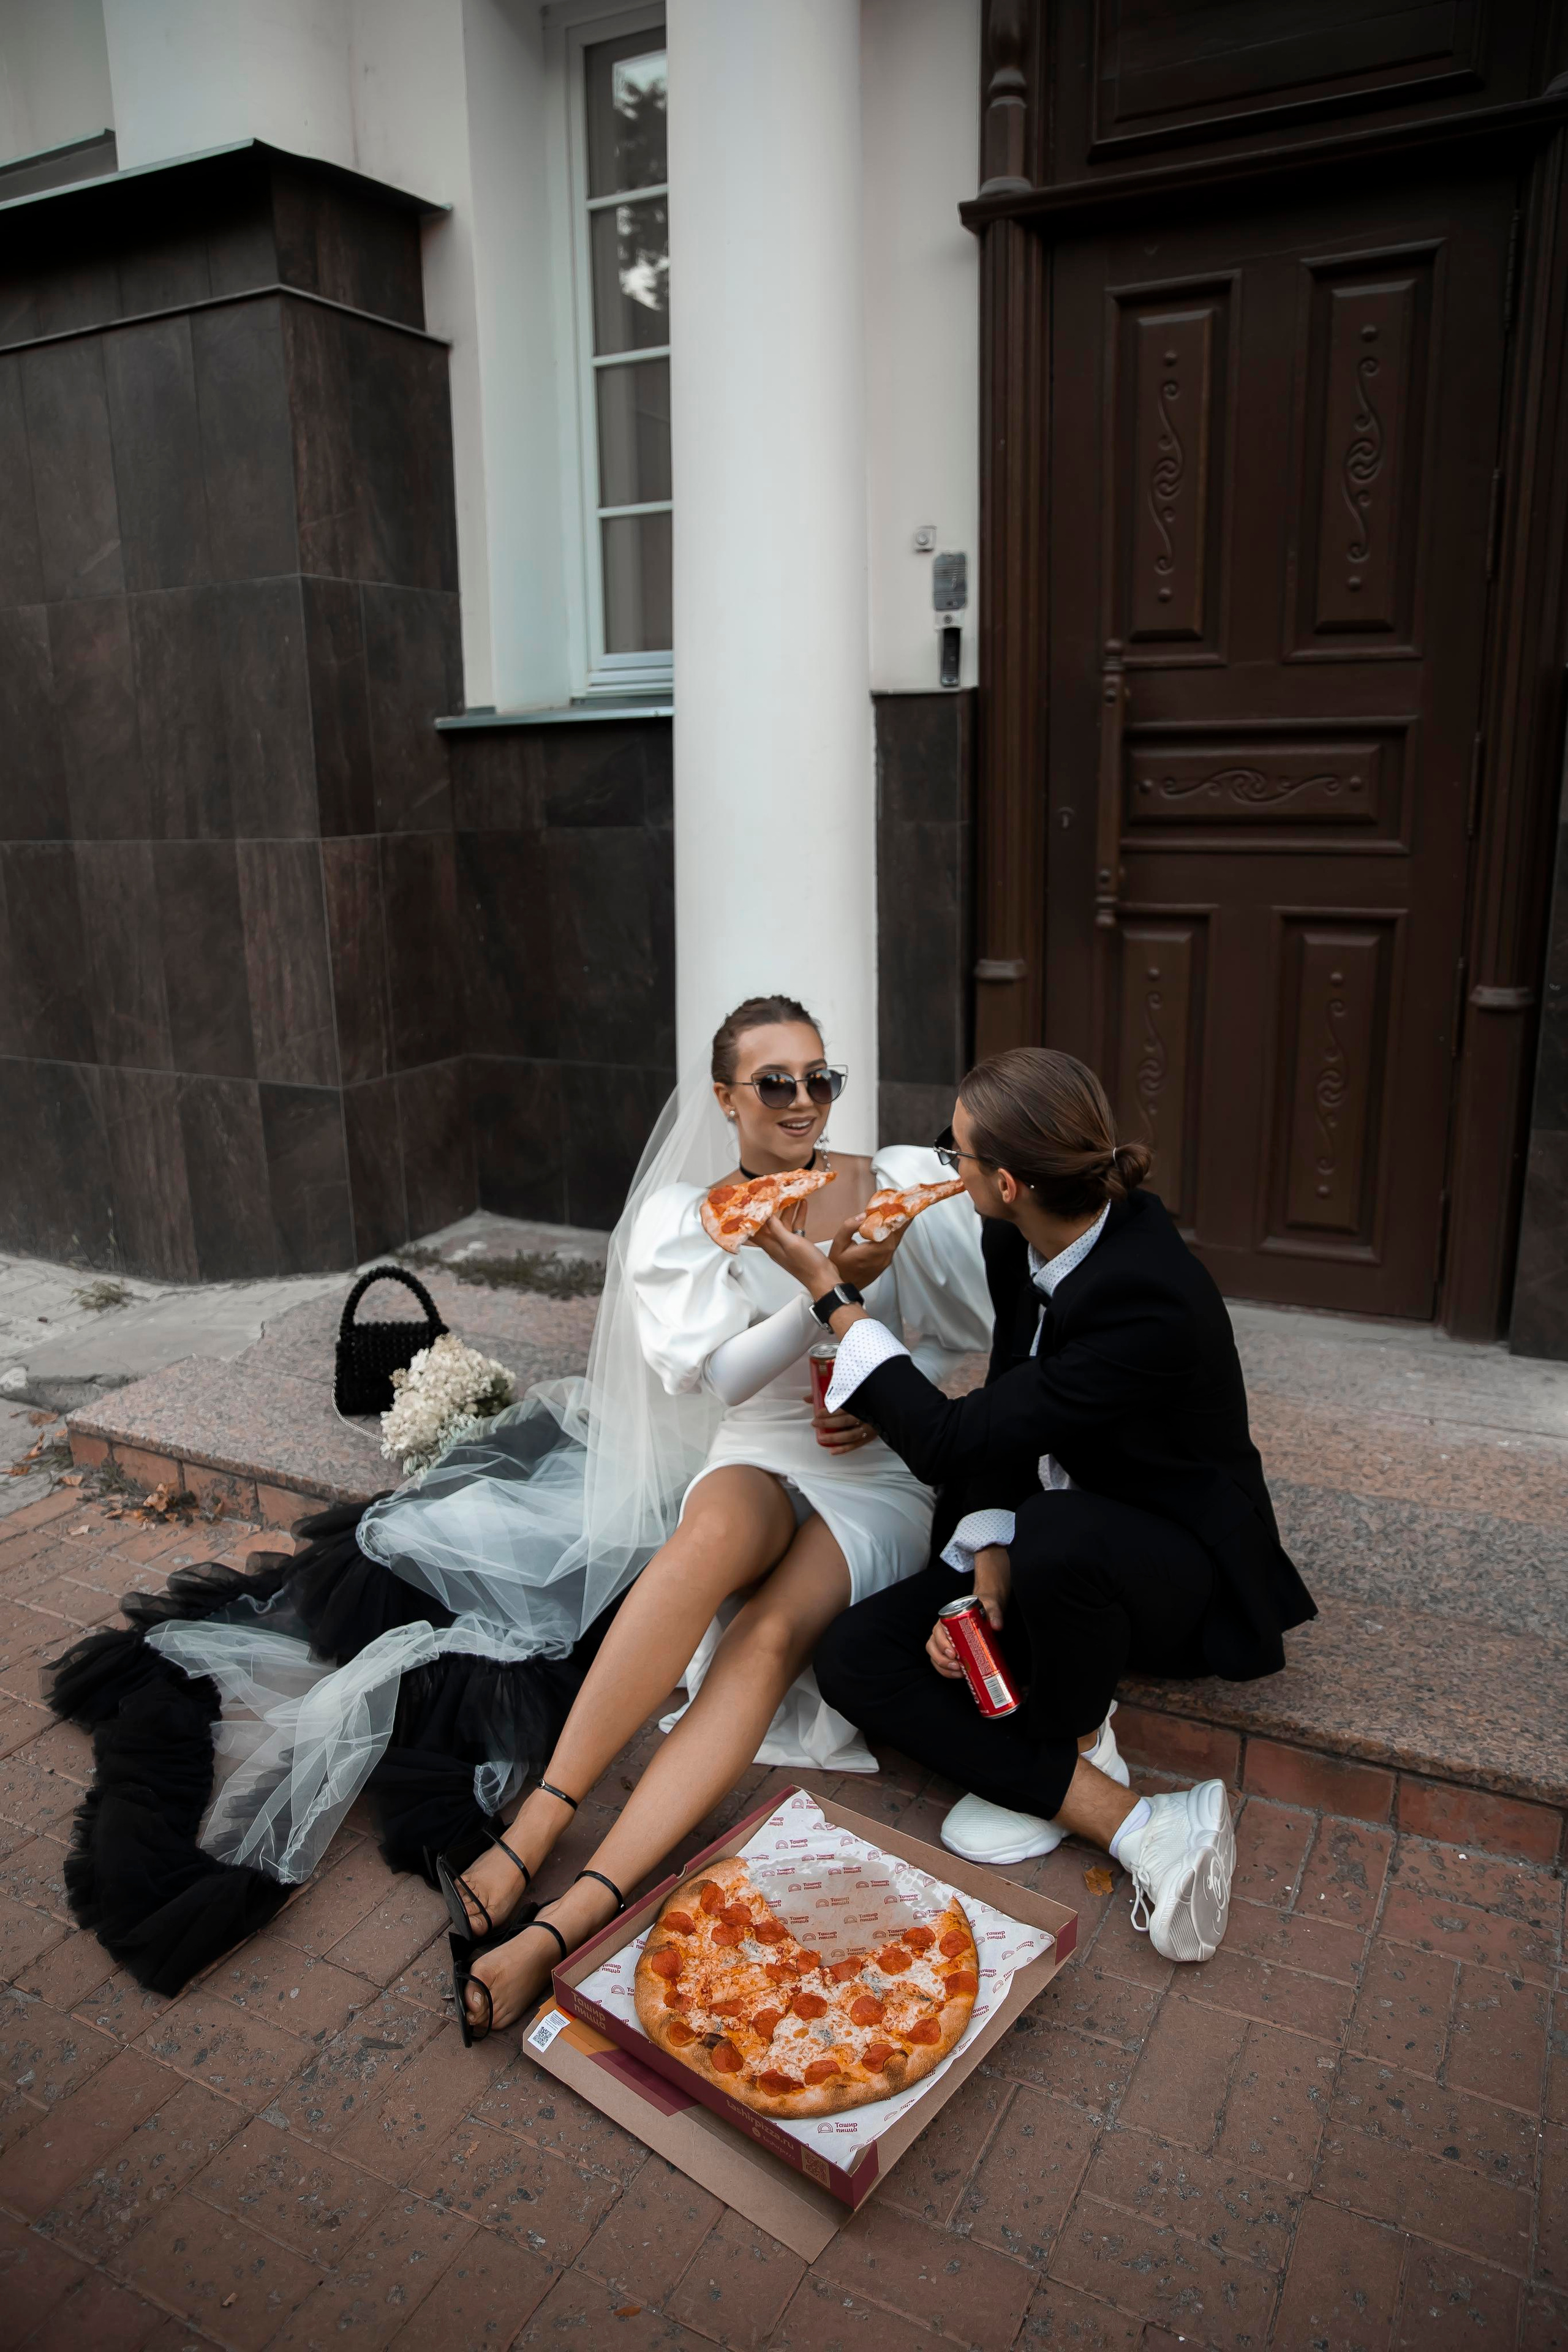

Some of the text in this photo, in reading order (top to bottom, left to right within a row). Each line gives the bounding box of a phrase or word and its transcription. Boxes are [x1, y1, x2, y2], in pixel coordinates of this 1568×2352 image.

[571, 1991, 606, 2021] Ташир
[574, 2003, 606, 2030] пицца
[726, 2100, 794, 2150] tashirpizza.ru
